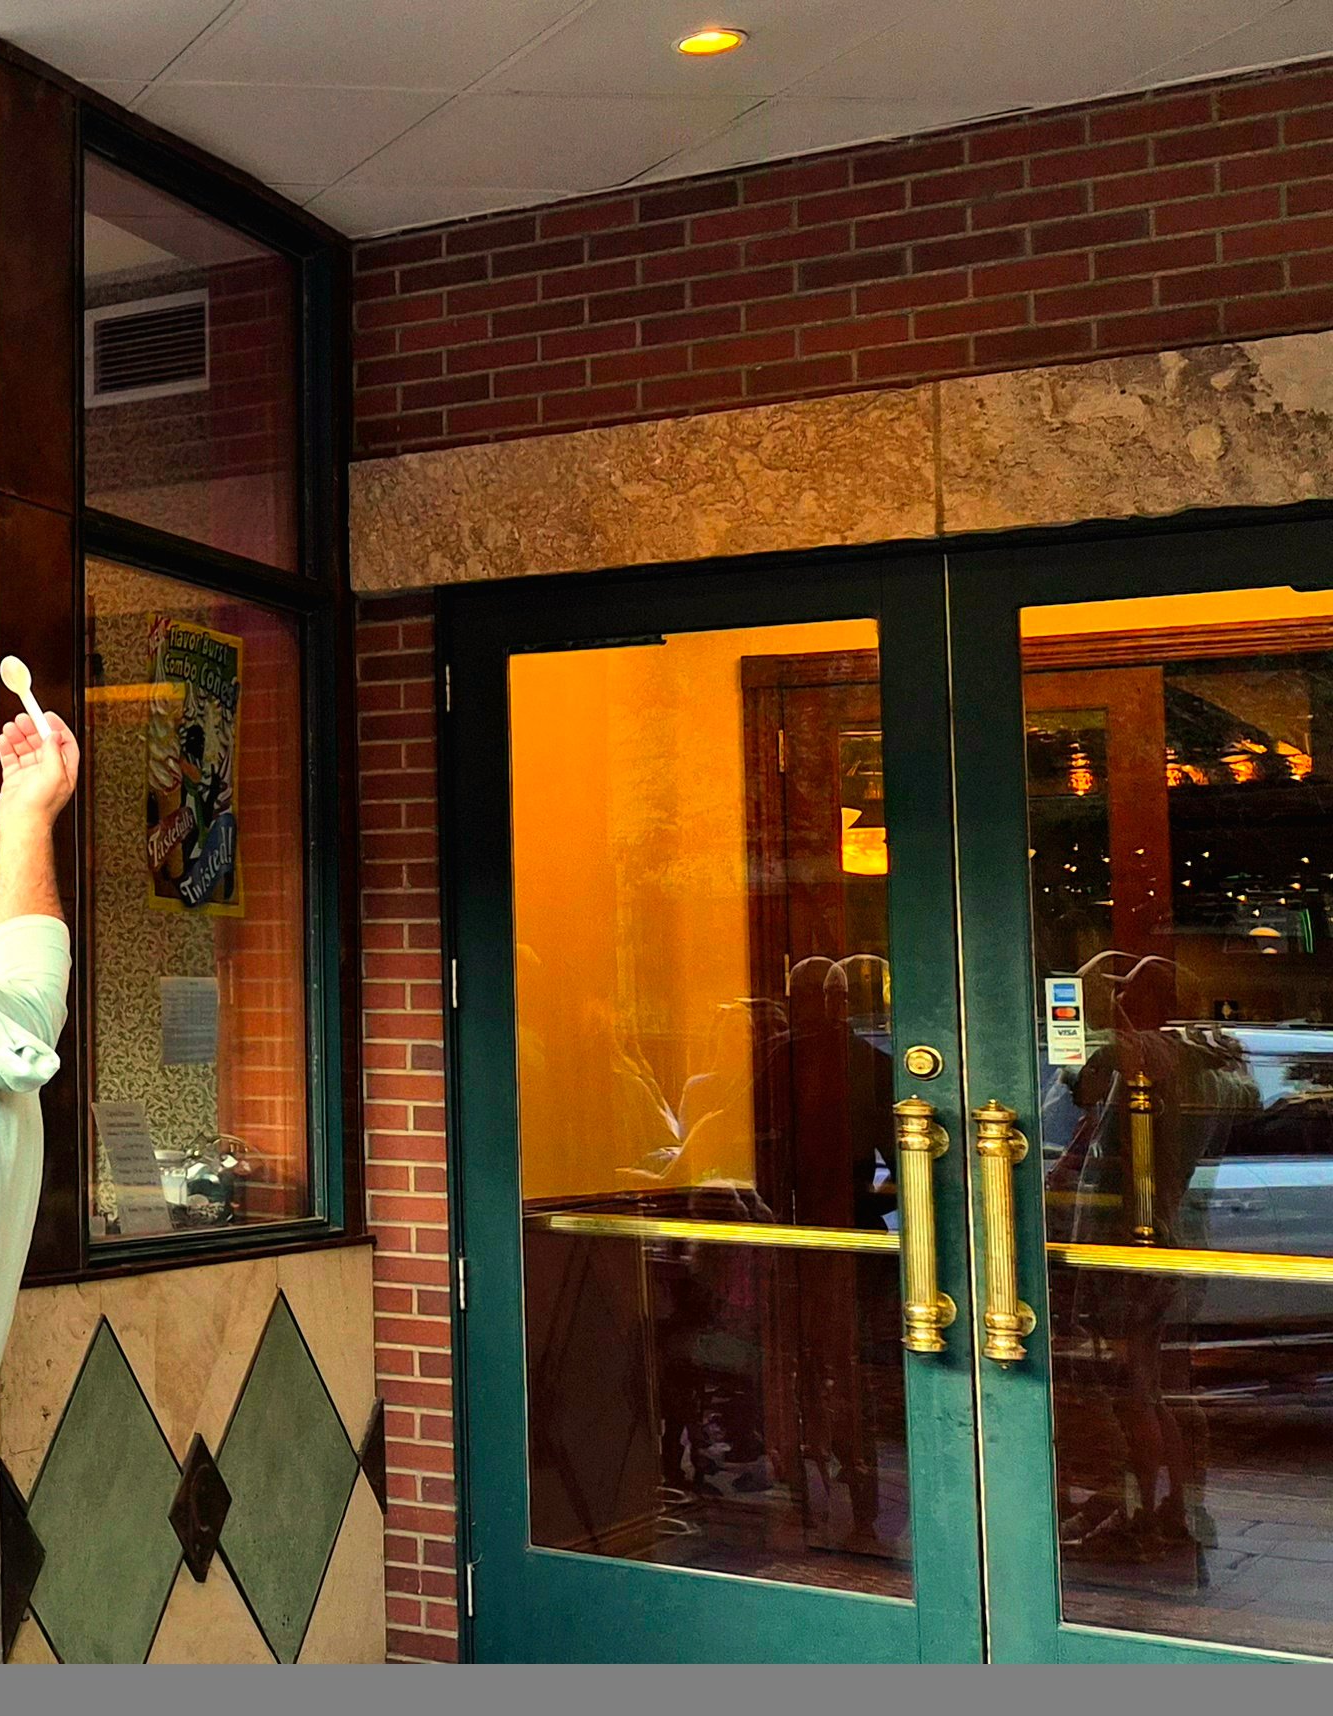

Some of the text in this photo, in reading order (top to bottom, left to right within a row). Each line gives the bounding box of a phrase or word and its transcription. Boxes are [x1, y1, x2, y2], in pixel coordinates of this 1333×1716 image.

[169, 625, 228, 665] Flavor Burst
[164, 653, 198, 681] Combo
